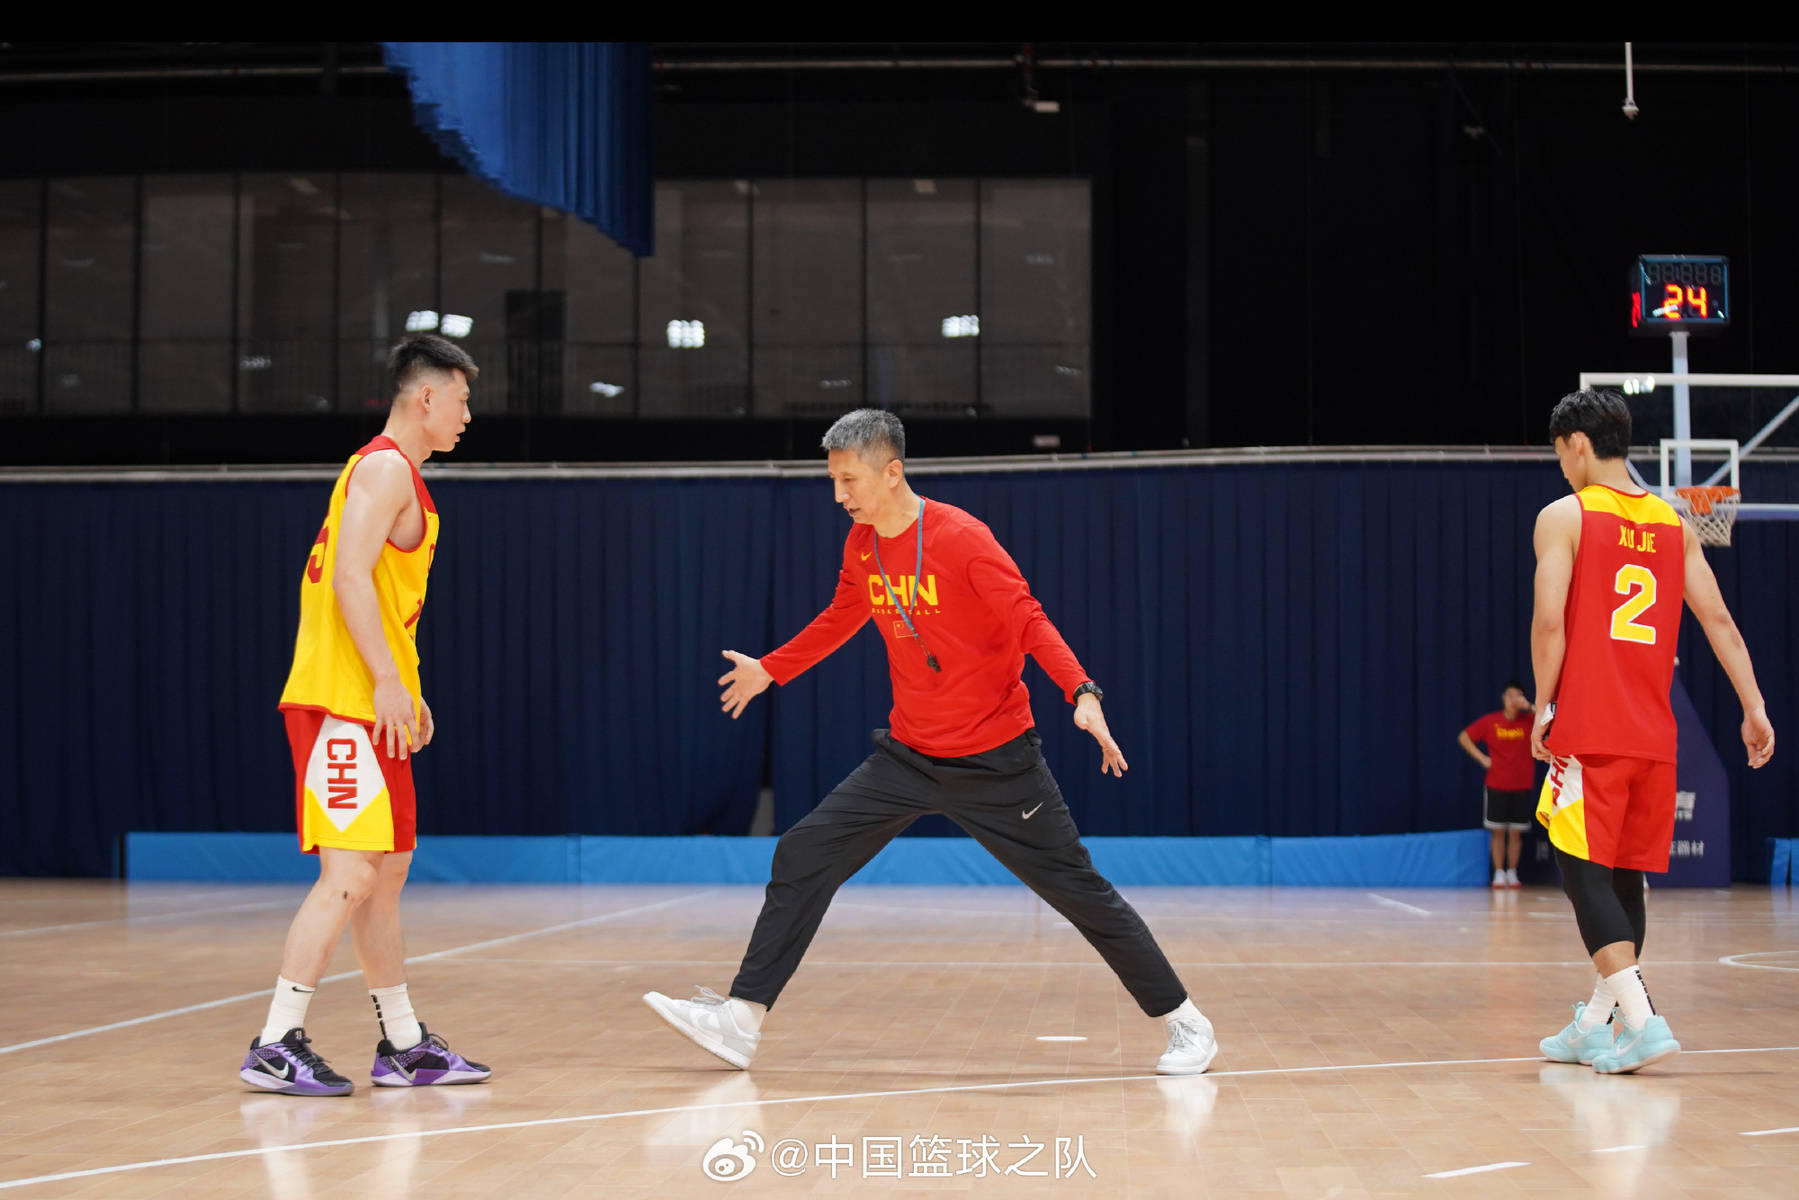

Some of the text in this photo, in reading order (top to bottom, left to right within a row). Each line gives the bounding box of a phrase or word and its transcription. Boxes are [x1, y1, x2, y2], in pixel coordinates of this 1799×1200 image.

[1662, 283, 1707, 320] 24
[1618, 525, 1657, 553] XU JIE
[868, 574, 939, 606] CHN
[1610, 563, 1657, 645] 2
[326, 738, 357, 809] CHN
